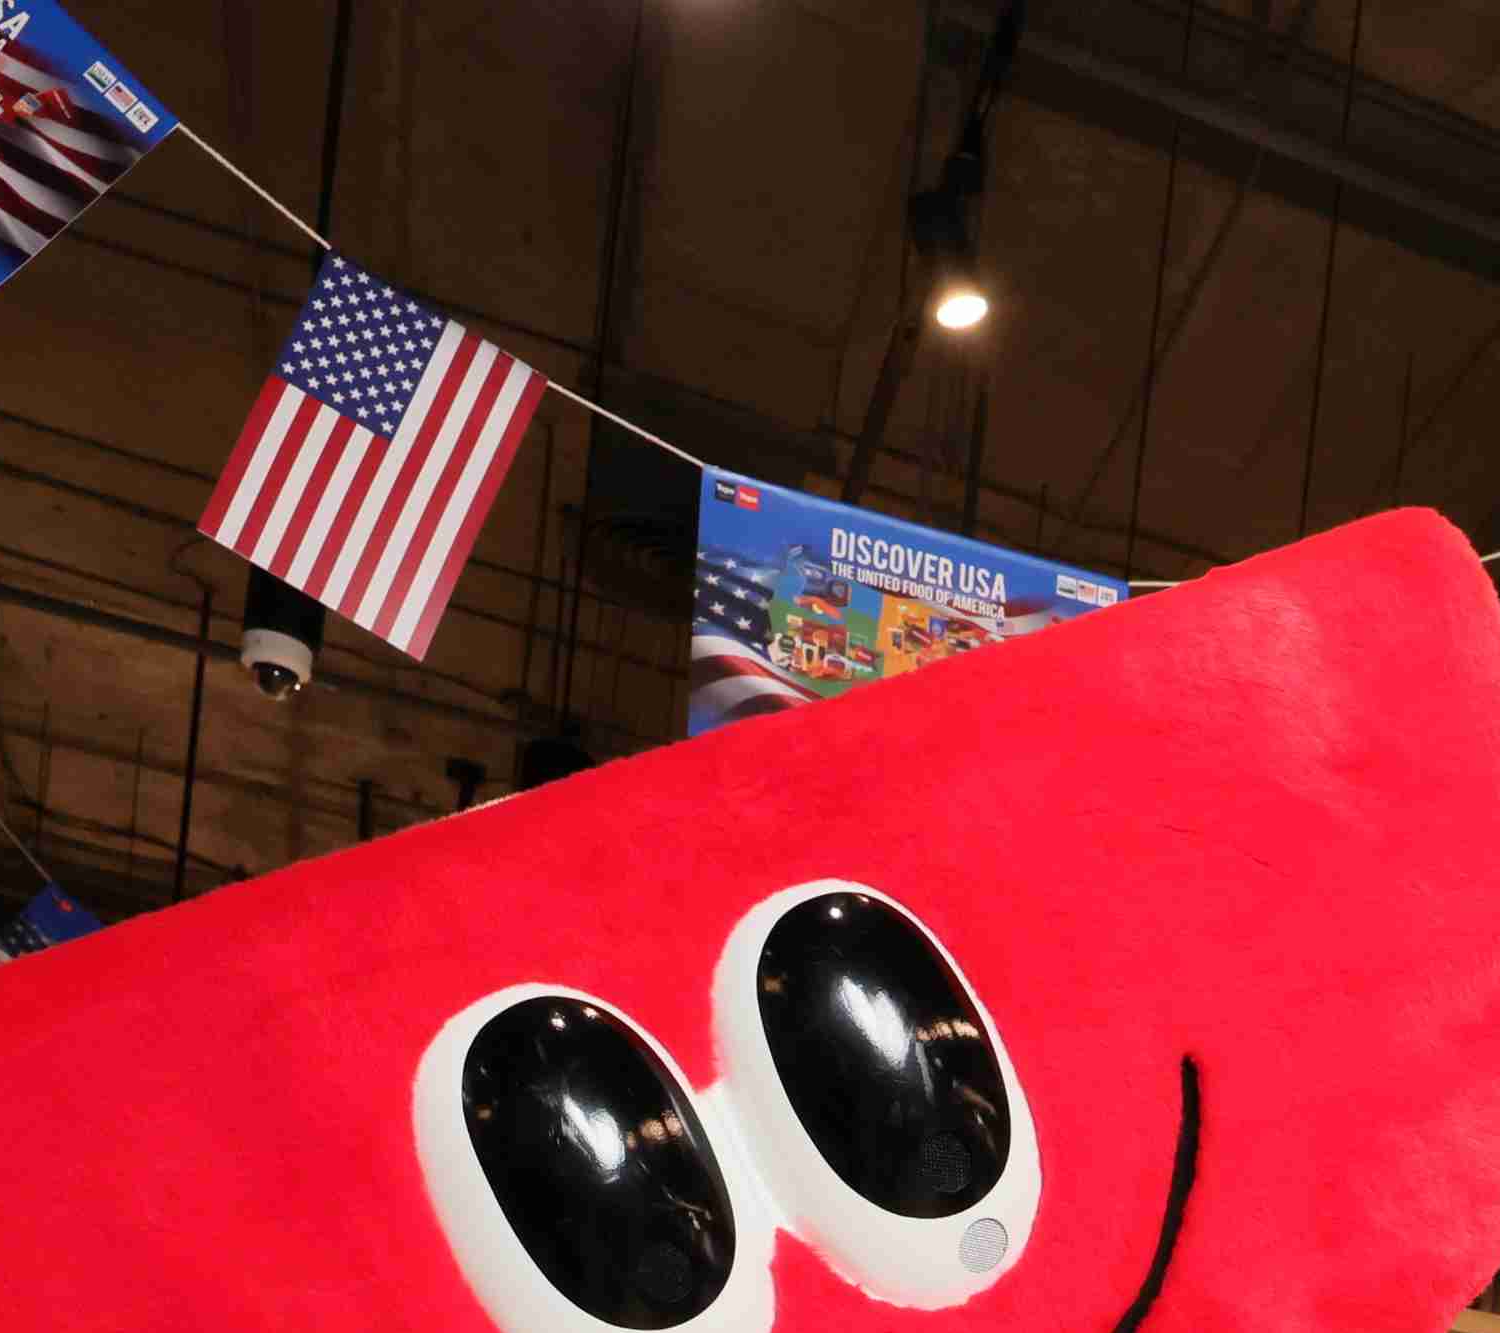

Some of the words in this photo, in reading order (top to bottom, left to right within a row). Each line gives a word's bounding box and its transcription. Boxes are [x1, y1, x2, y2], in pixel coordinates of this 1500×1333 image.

[831, 527, 954, 589] DISCOVER
[958, 562, 1007, 603] USA
[831, 561, 855, 579] THE
[856, 565, 901, 593] UNITED
[901, 577, 937, 602] FOOD
[952, 590, 1006, 620] AMERICA
